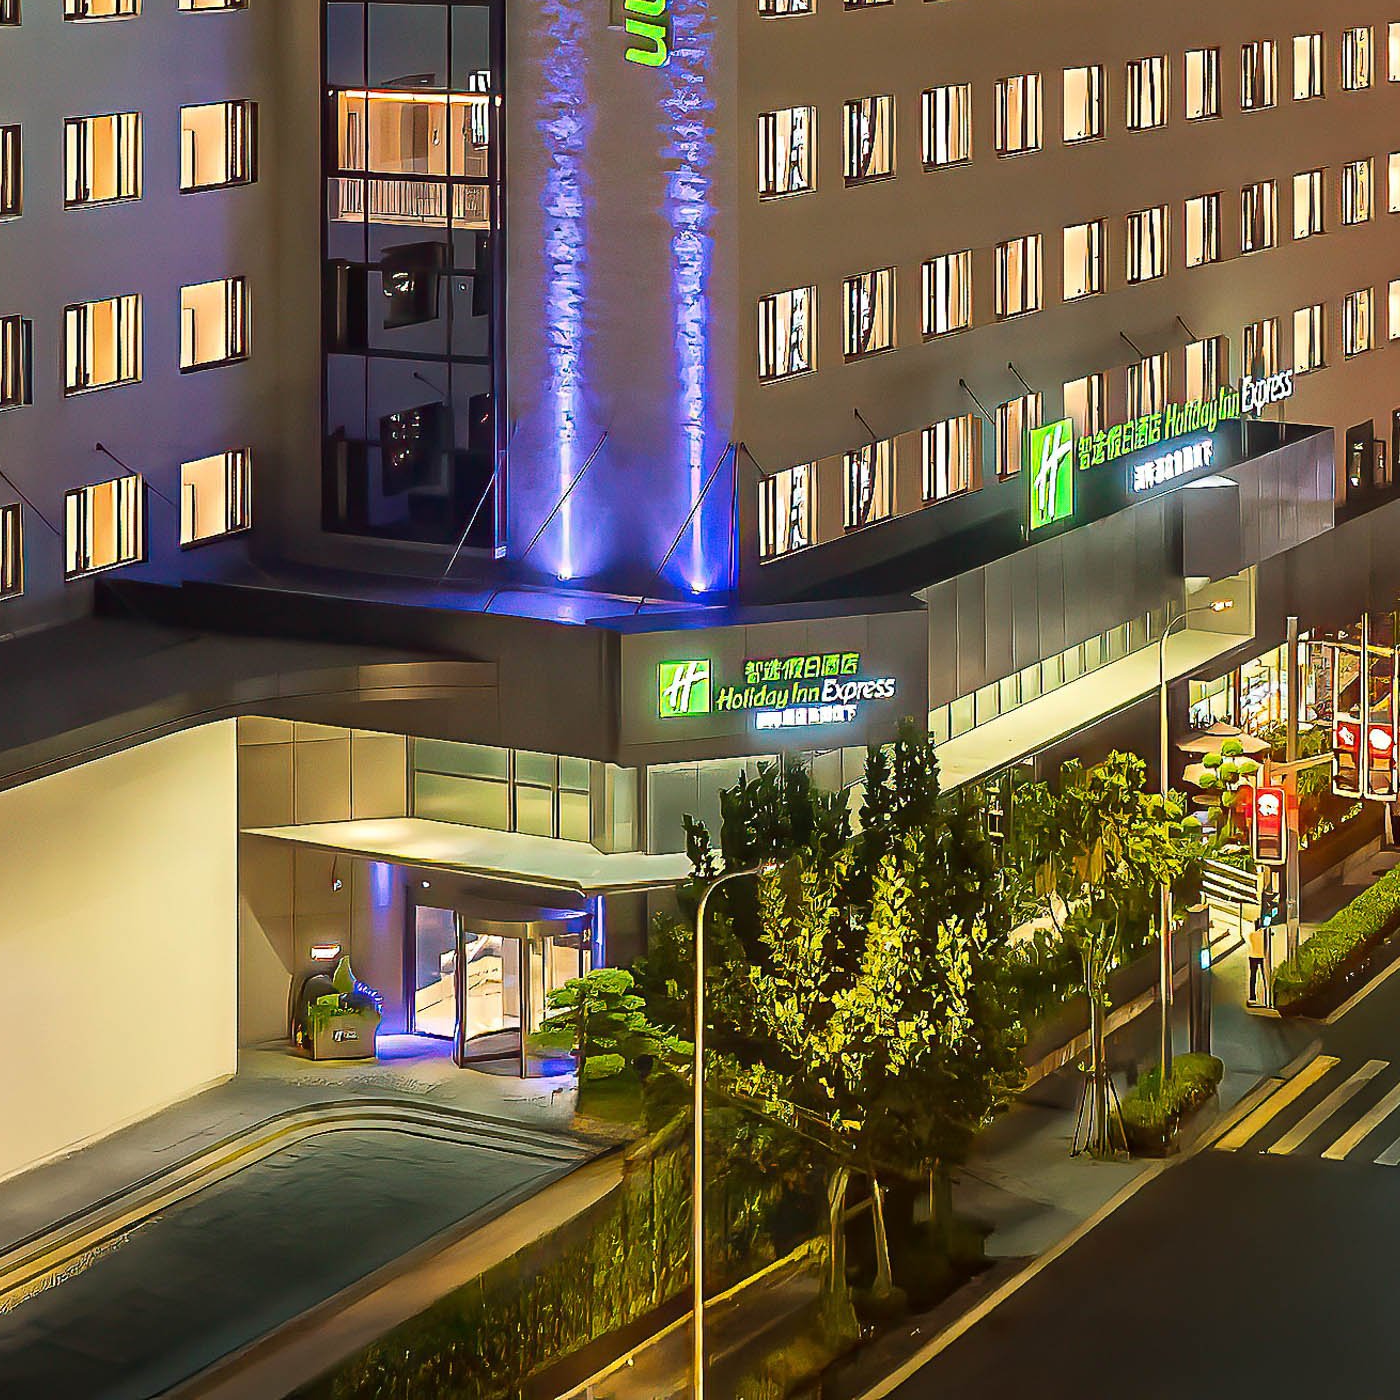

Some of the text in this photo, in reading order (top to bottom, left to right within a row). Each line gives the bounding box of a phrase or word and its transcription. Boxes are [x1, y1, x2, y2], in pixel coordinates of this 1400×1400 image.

[1165, 369, 1293, 439] Holiday Inn Express
[716, 678, 895, 711] Holiday Inn Express
